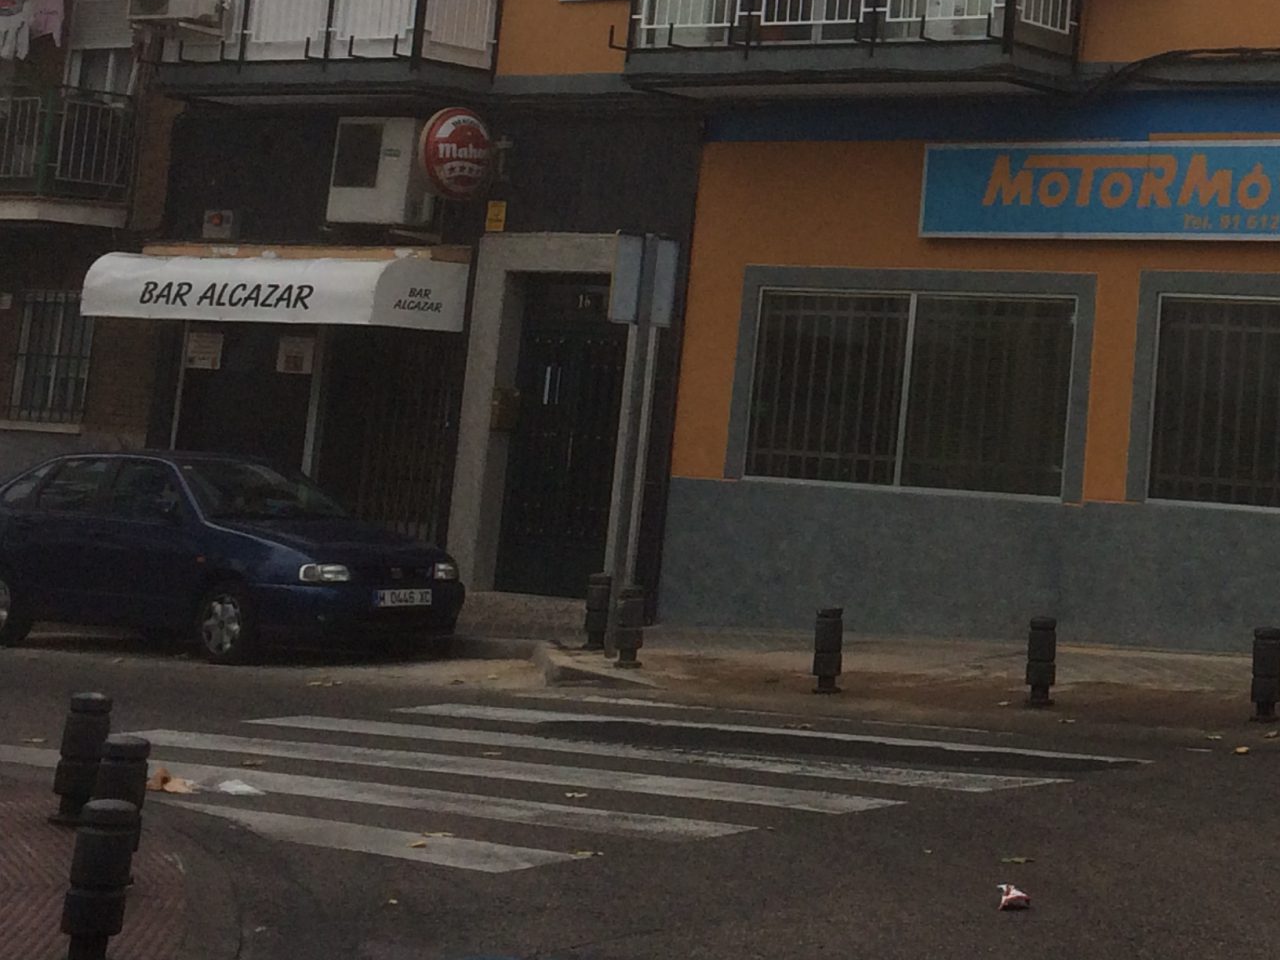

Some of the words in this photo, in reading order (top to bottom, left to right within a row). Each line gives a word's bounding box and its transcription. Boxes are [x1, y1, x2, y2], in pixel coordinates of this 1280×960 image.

[1184, 213, 1213, 229] Tel.
[139, 281, 193, 306] BAR
[196, 283, 315, 310] ALCAZAR
[408, 287, 432, 299] BAR
[393, 299, 443, 313] ALCAZAR
